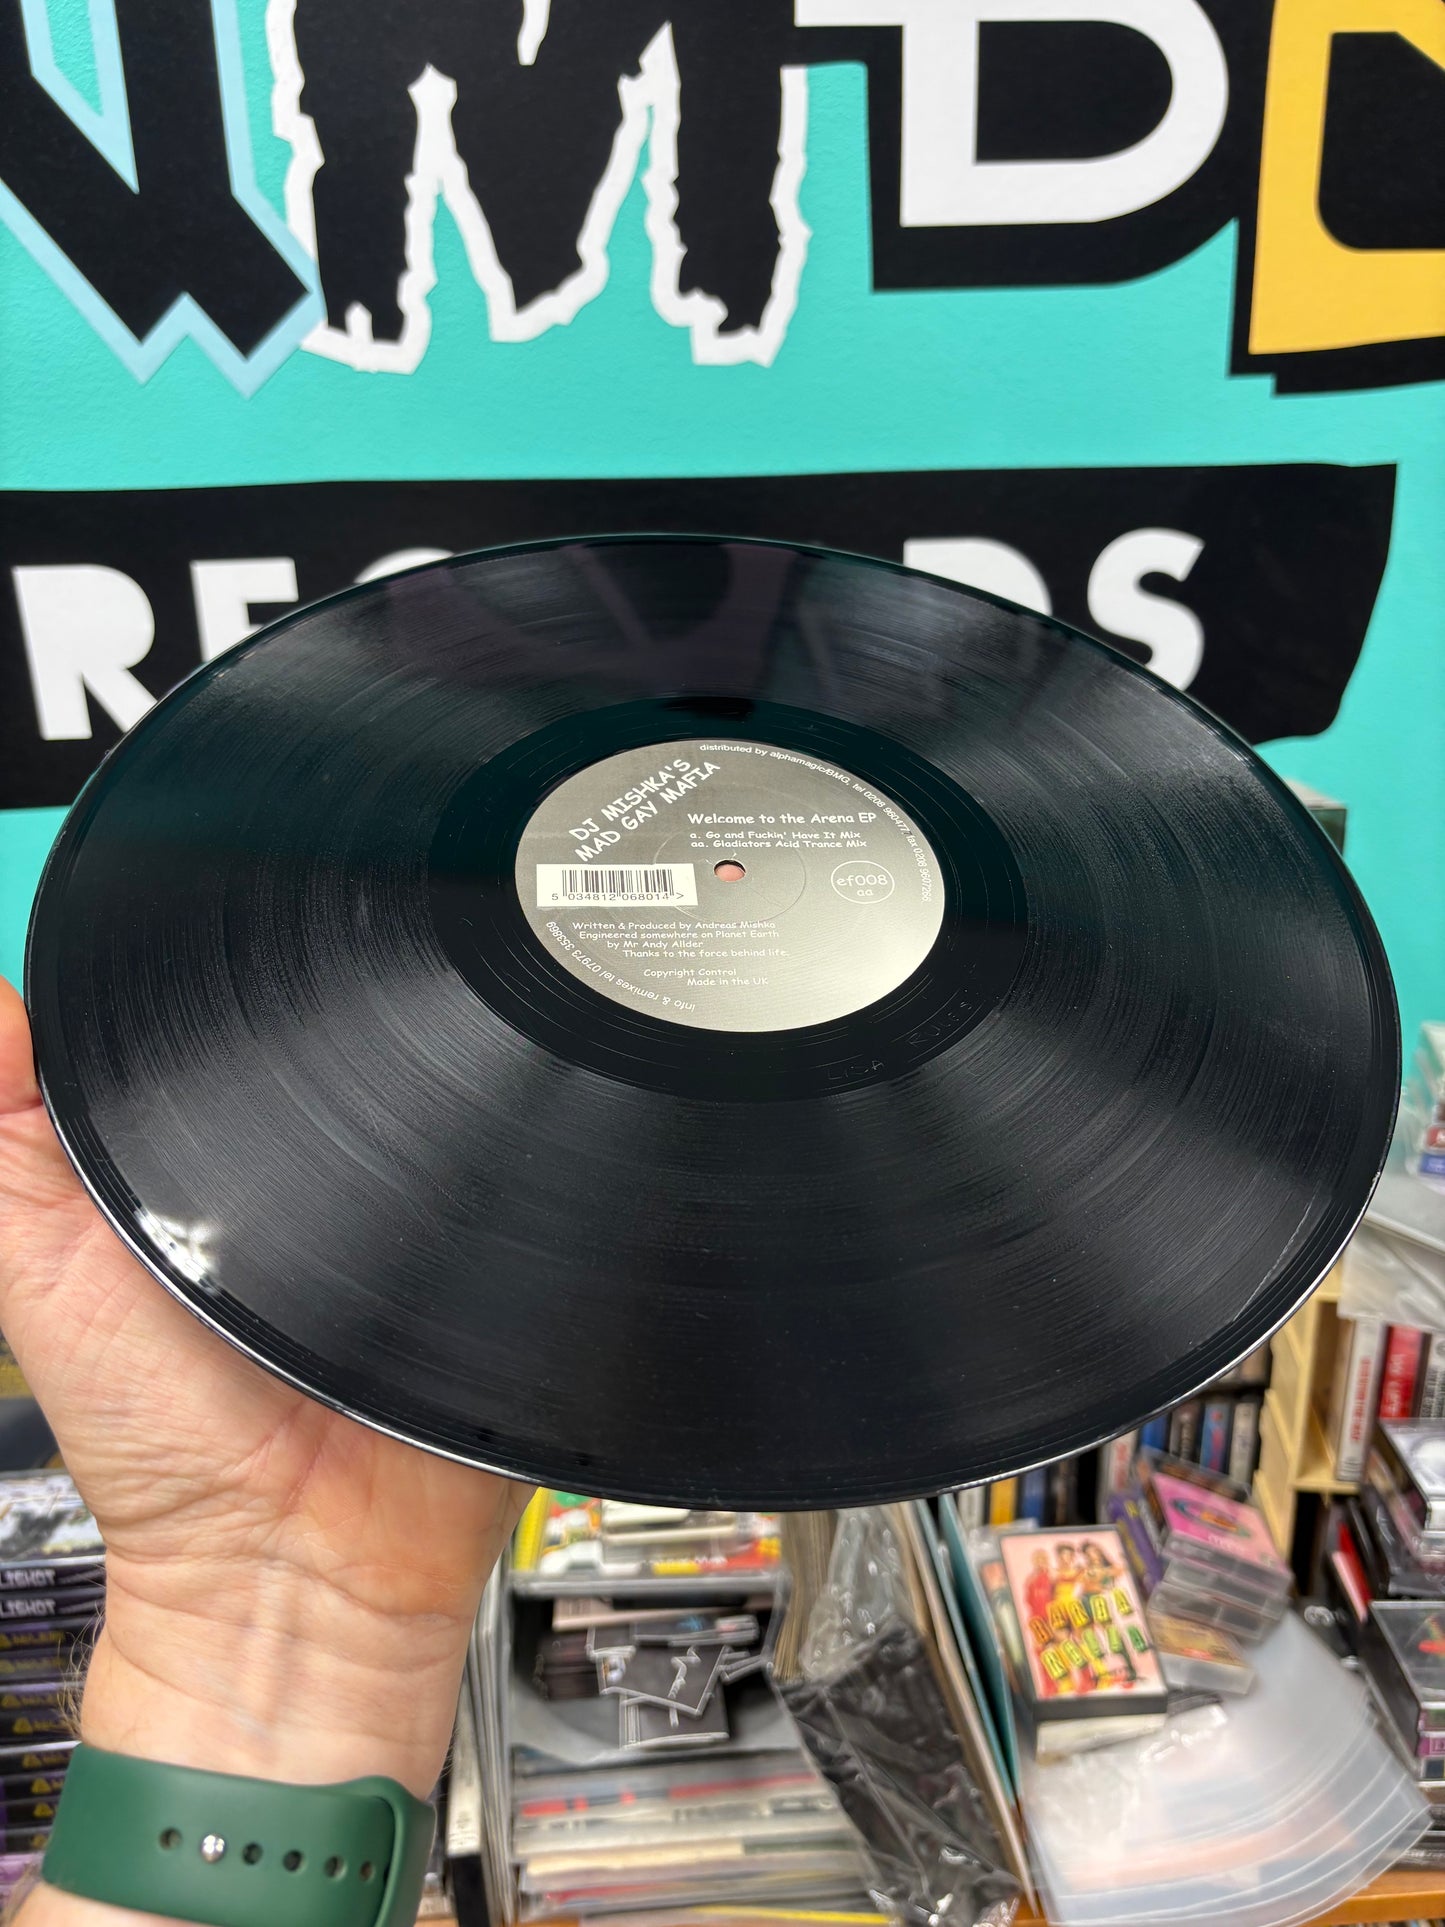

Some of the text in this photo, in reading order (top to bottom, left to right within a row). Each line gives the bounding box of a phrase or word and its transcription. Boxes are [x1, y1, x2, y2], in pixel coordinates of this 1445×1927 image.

[569, 759, 691, 841] DJ MISHKA'S
[700, 744, 752, 753] distributed
[755, 747, 768, 756] by
[852, 783, 866, 793] tel
[863, 791, 886, 807] 0208
[906, 834, 918, 848] fax
[574, 761, 721, 862] MAD GAY MAFIA
[687, 812, 877, 824] Welcome to the Arena EP
[705, 831, 721, 839] Go
[724, 831, 745, 839] and
[747, 831, 787, 840] Fuckin'
[792, 831, 820, 839] Have
[823, 831, 836, 839] It
[840, 831, 861, 839] Mix
[713, 840, 772, 848] Gladiators
[775, 840, 801, 848] Acid
[802, 840, 843, 848] Trance
[846, 840, 868, 848] Mix
[836, 874, 889, 887] ef008
[856, 889, 874, 897] aa
[572, 922, 615, 930] Written
[617, 922, 626, 930] &
[628, 922, 676, 930] Produced
[679, 921, 692, 931] by
[739, 920, 776, 929] Mishka
[579, 931, 638, 940] Engineered
[640, 931, 699, 939] somewhere
[715, 930, 746, 938] Planet
[750, 930, 780, 938] Earth
[607, 941, 620, 950] by
[642, 941, 669, 950] Andy
[622, 949, 660, 958] Thanks
[678, 949, 697, 957] the
[699, 949, 729, 957] force
[730, 949, 766, 957] behind
[571, 949, 602, 973] 07973
[598, 970, 616, 982] tel
[643, 968, 737, 978] Copyright Control
[687, 977, 716, 986] Made
[752, 977, 769, 985] UK
[615, 979, 659, 1000] remixes
[662, 996, 671, 1005] &
